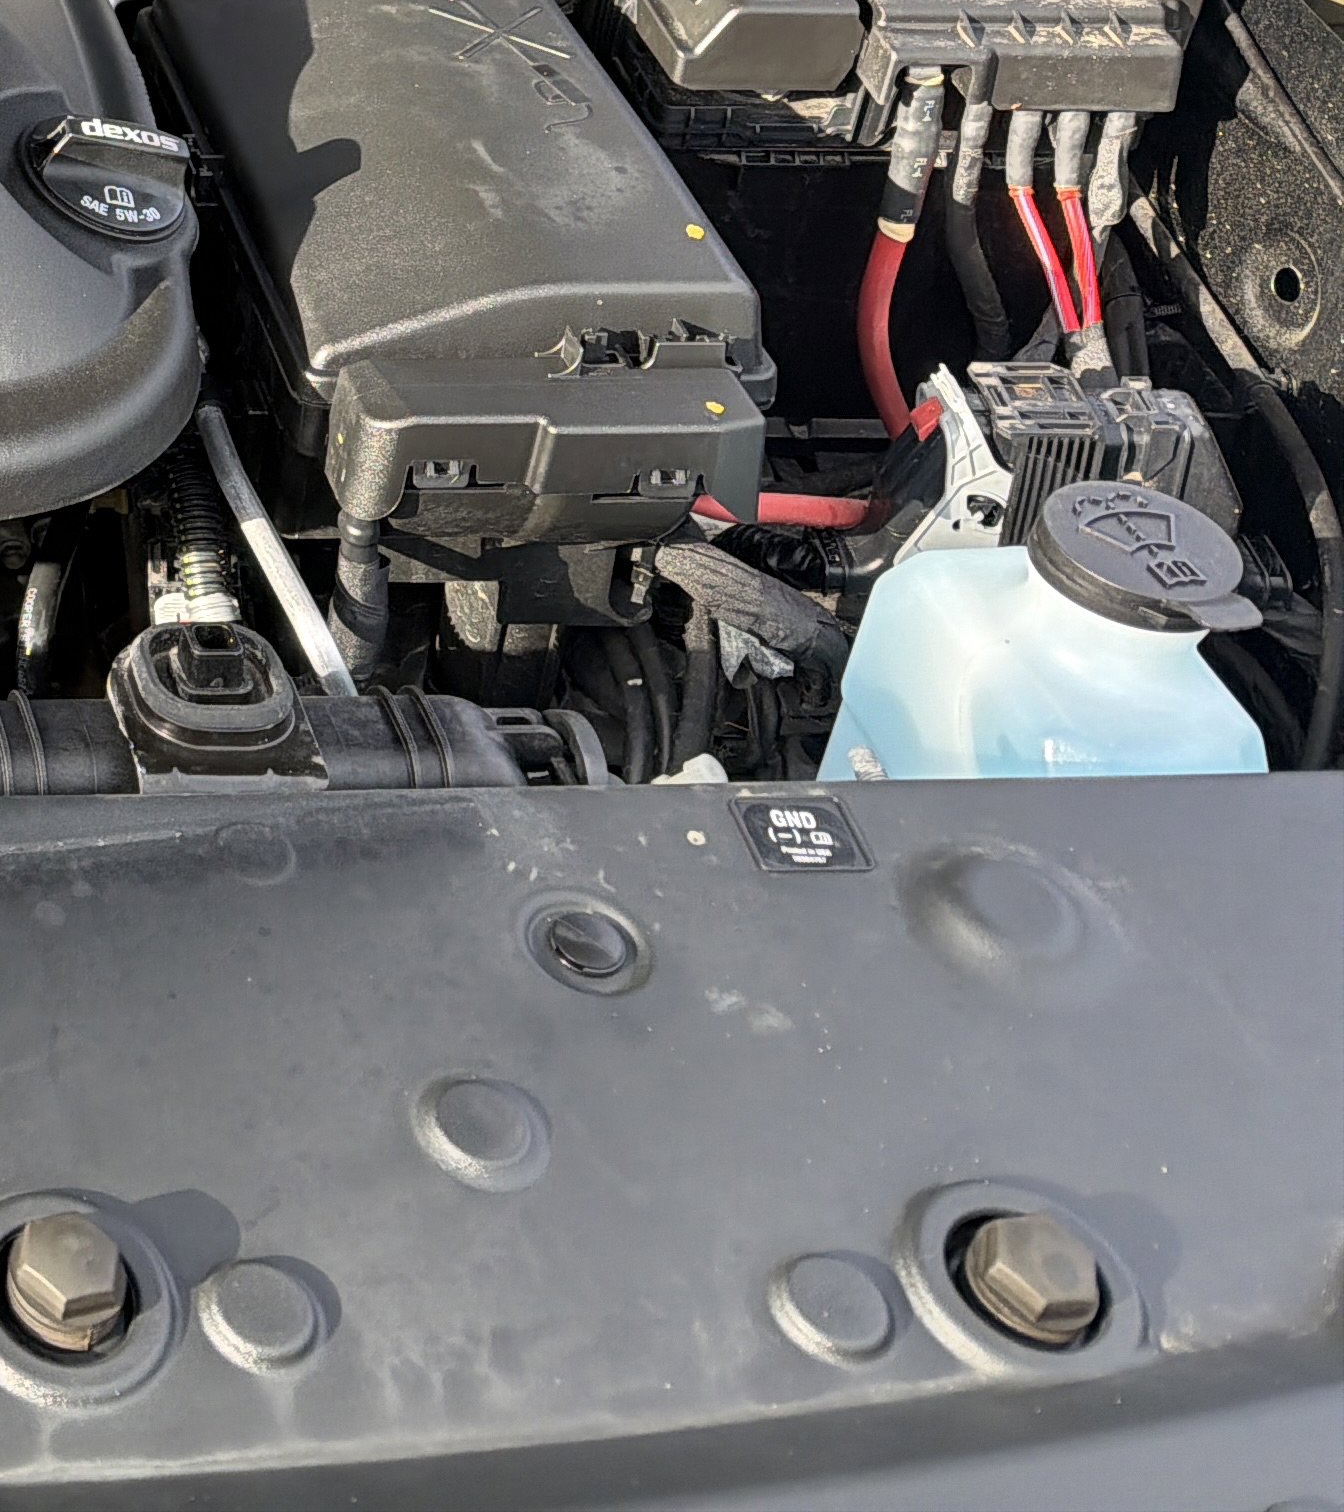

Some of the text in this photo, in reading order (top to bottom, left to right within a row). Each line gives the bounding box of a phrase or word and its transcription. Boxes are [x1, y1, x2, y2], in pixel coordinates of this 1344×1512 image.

[80, 118, 179, 152] dexos
[80, 195, 161, 223] SAE 5W-30
[19, 587, 38, 628] COOPER
[769, 808, 816, 829] GND
